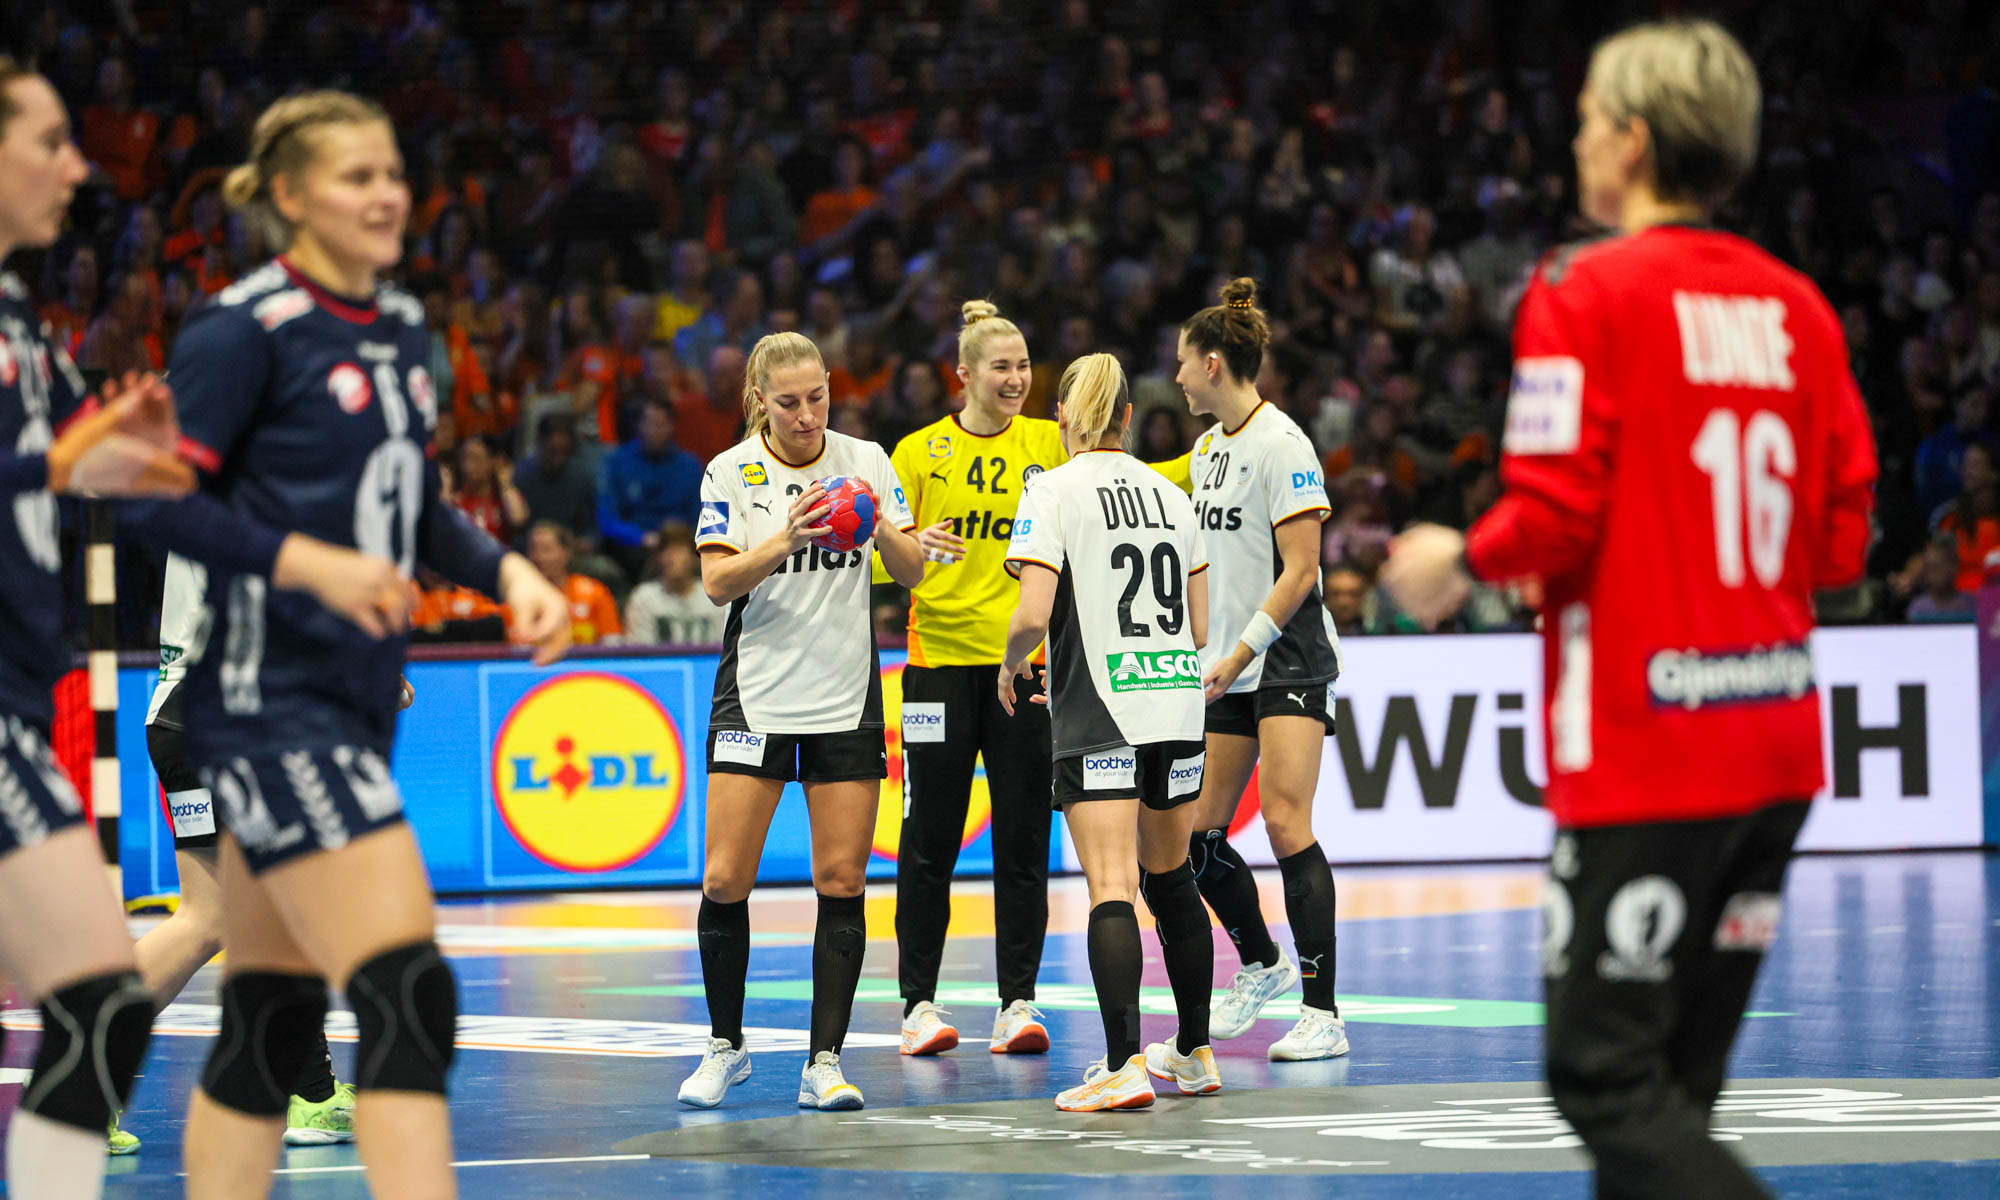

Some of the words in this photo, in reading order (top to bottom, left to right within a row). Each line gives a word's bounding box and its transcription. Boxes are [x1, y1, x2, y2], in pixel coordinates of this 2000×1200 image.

[967, 456, 1008, 494] 42
[1202, 451, 1230, 490] 20
[1096, 478, 1176, 530] DÖLL
[1690, 405, 1799, 590] 16
[1013, 519, 1032, 536] KB
[1110, 541, 1184, 637] 29
[1111, 652, 1201, 681] ALSCO
[902, 713, 942, 725] brother
[1085, 756, 1134, 770] brother
[1170, 765, 1202, 780] brothe
